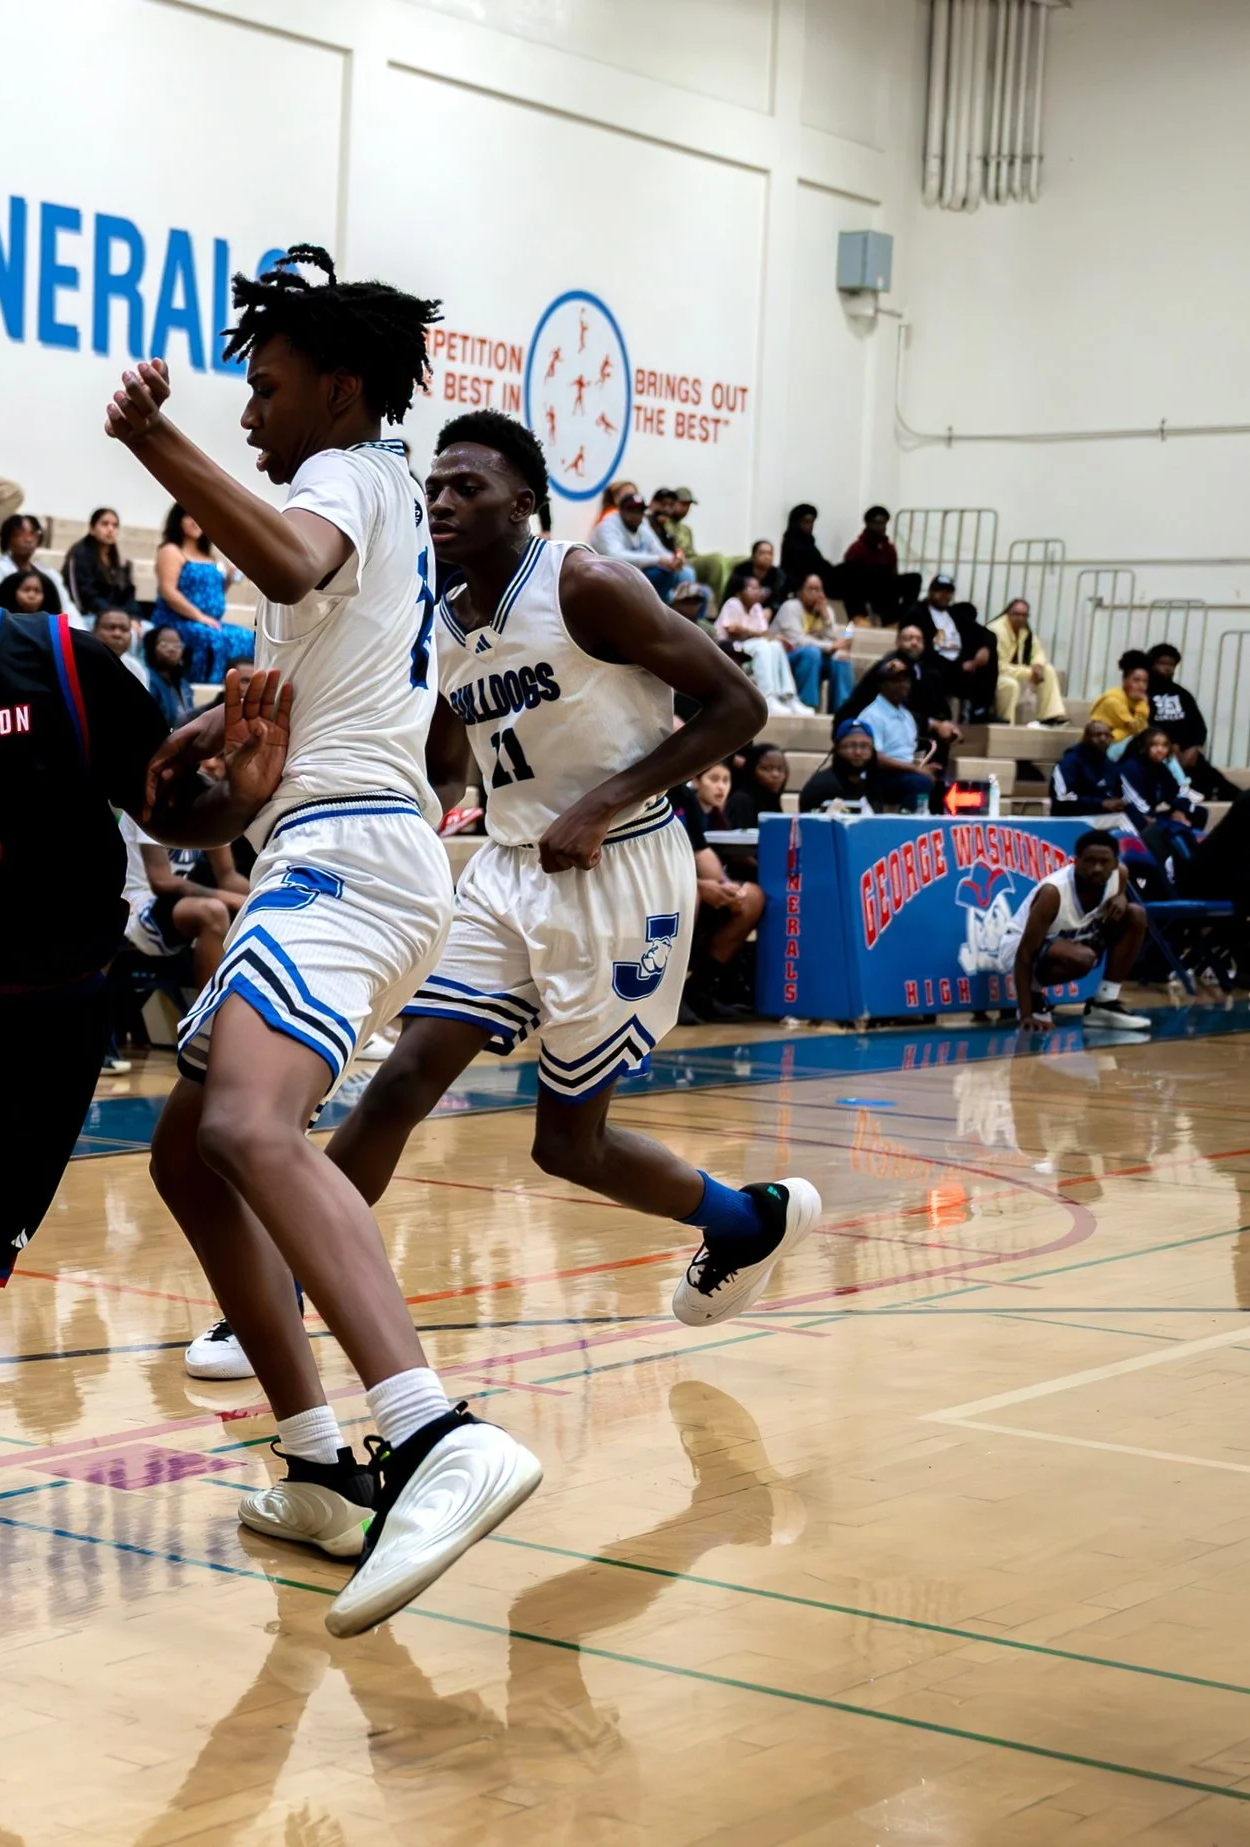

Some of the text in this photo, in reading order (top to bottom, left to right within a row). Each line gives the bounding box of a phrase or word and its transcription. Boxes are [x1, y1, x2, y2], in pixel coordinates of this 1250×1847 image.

[445, 371, 494, 408] BEST
[502, 382, 521, 413] IN
[635, 368, 748, 413] BRINGS OUT
[633, 404, 665, 436] THE
[450, 661, 561, 726] BULLDOGS
[490, 727, 535, 789] 11
[785, 816, 802, 1002] NERALS
[860, 824, 1078, 950] GEORGE WASHING
[905, 974, 1079, 1008] HIGH SCOL
